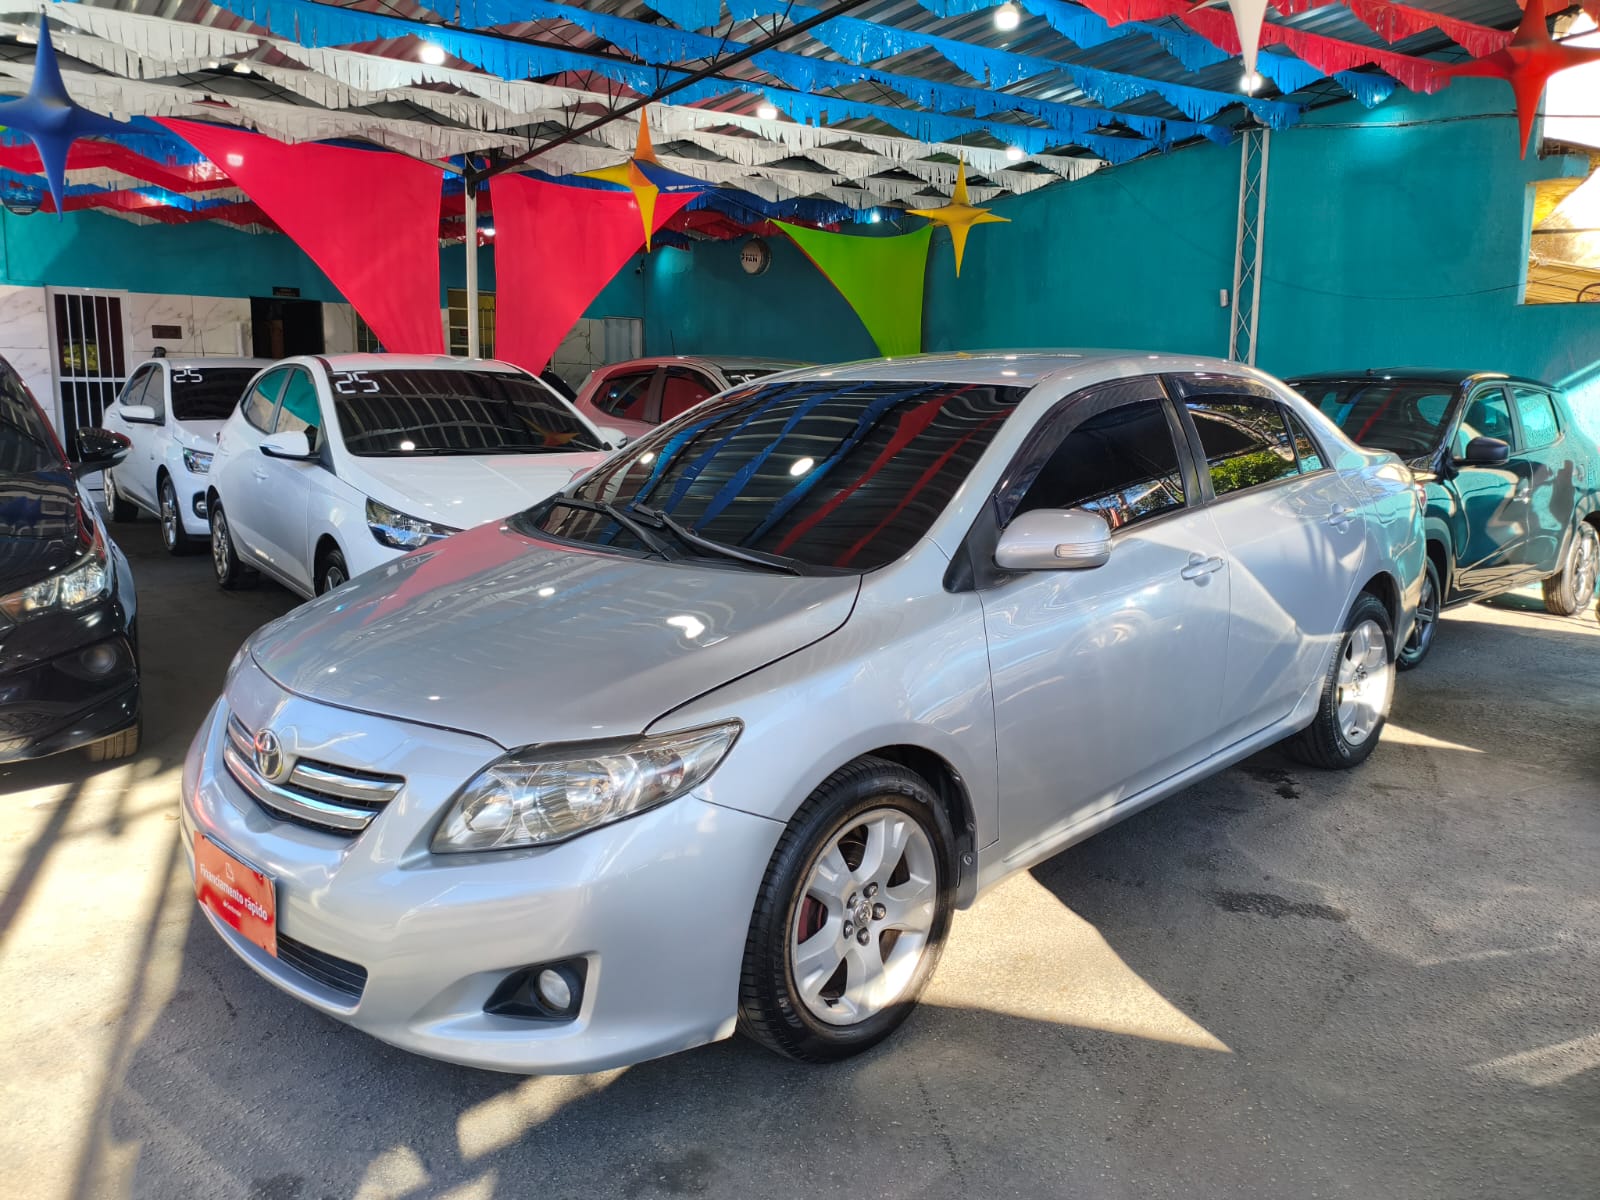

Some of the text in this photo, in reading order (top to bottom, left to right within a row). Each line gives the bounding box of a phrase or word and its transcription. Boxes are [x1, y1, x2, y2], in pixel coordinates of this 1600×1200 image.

[173, 367, 203, 383] 25
[333, 371, 380, 394] 25
[200, 863, 244, 905] Financiamento
[244, 897, 268, 921] rápido
